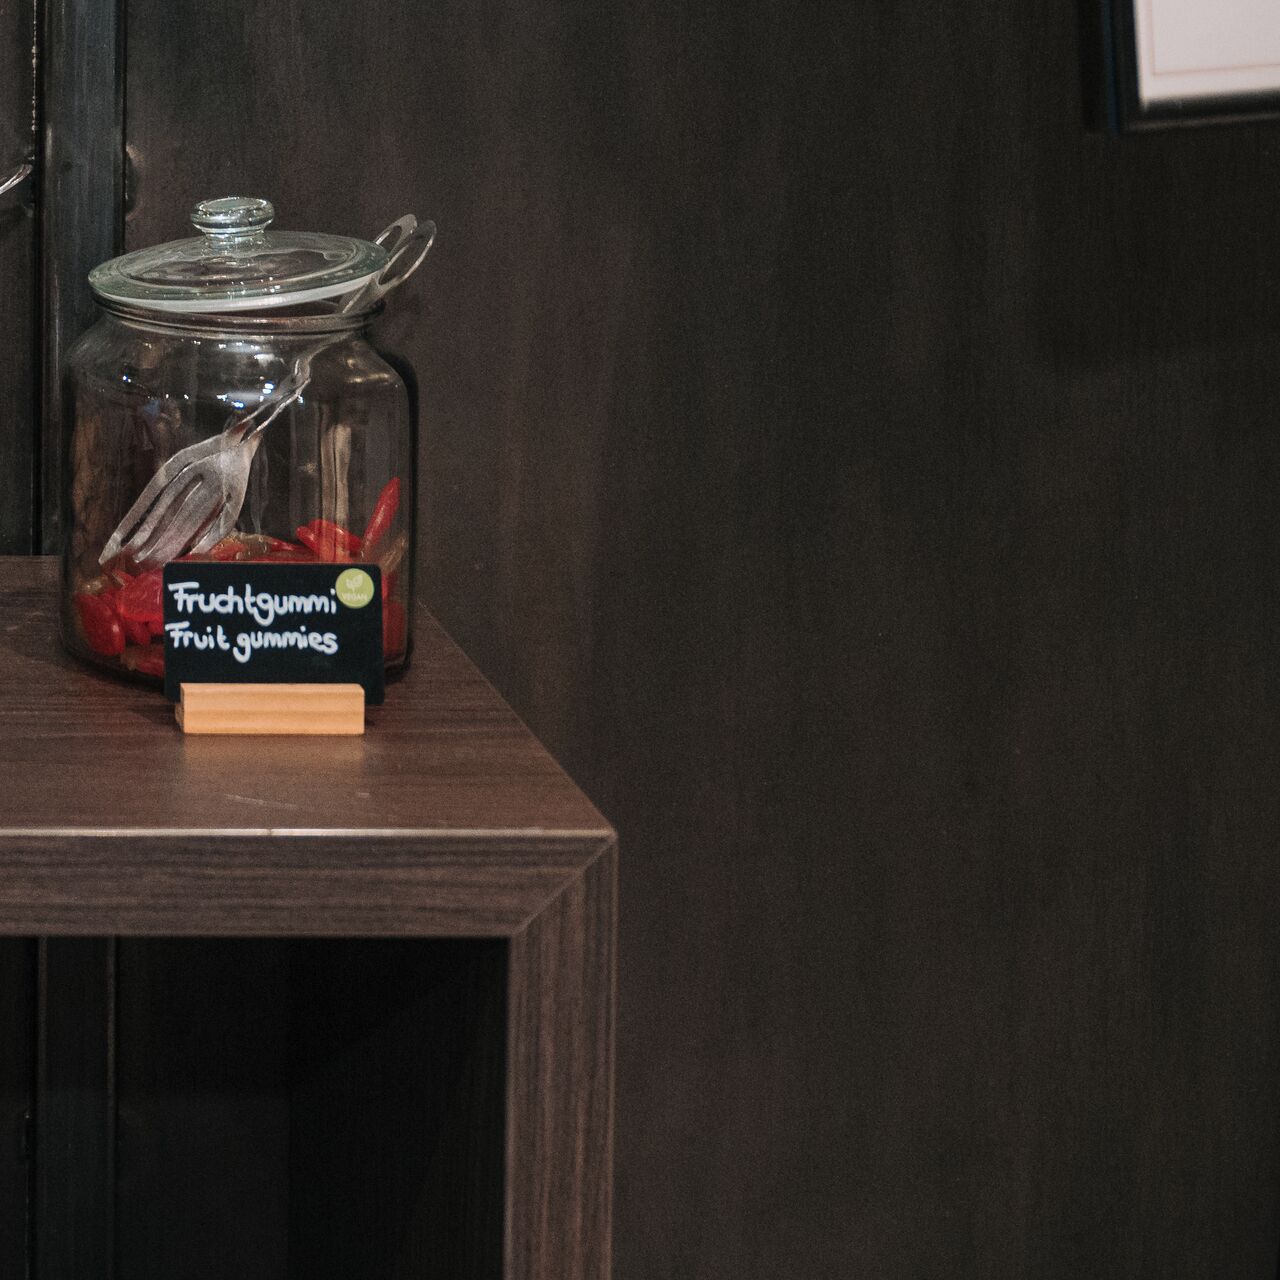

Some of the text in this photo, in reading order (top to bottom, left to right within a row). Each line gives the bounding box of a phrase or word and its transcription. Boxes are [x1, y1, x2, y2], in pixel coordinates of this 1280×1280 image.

[168, 581, 337, 626] Fruchtgummi
[341, 593, 368, 601] VEGAN
[165, 620, 339, 663] Fruit gummies
